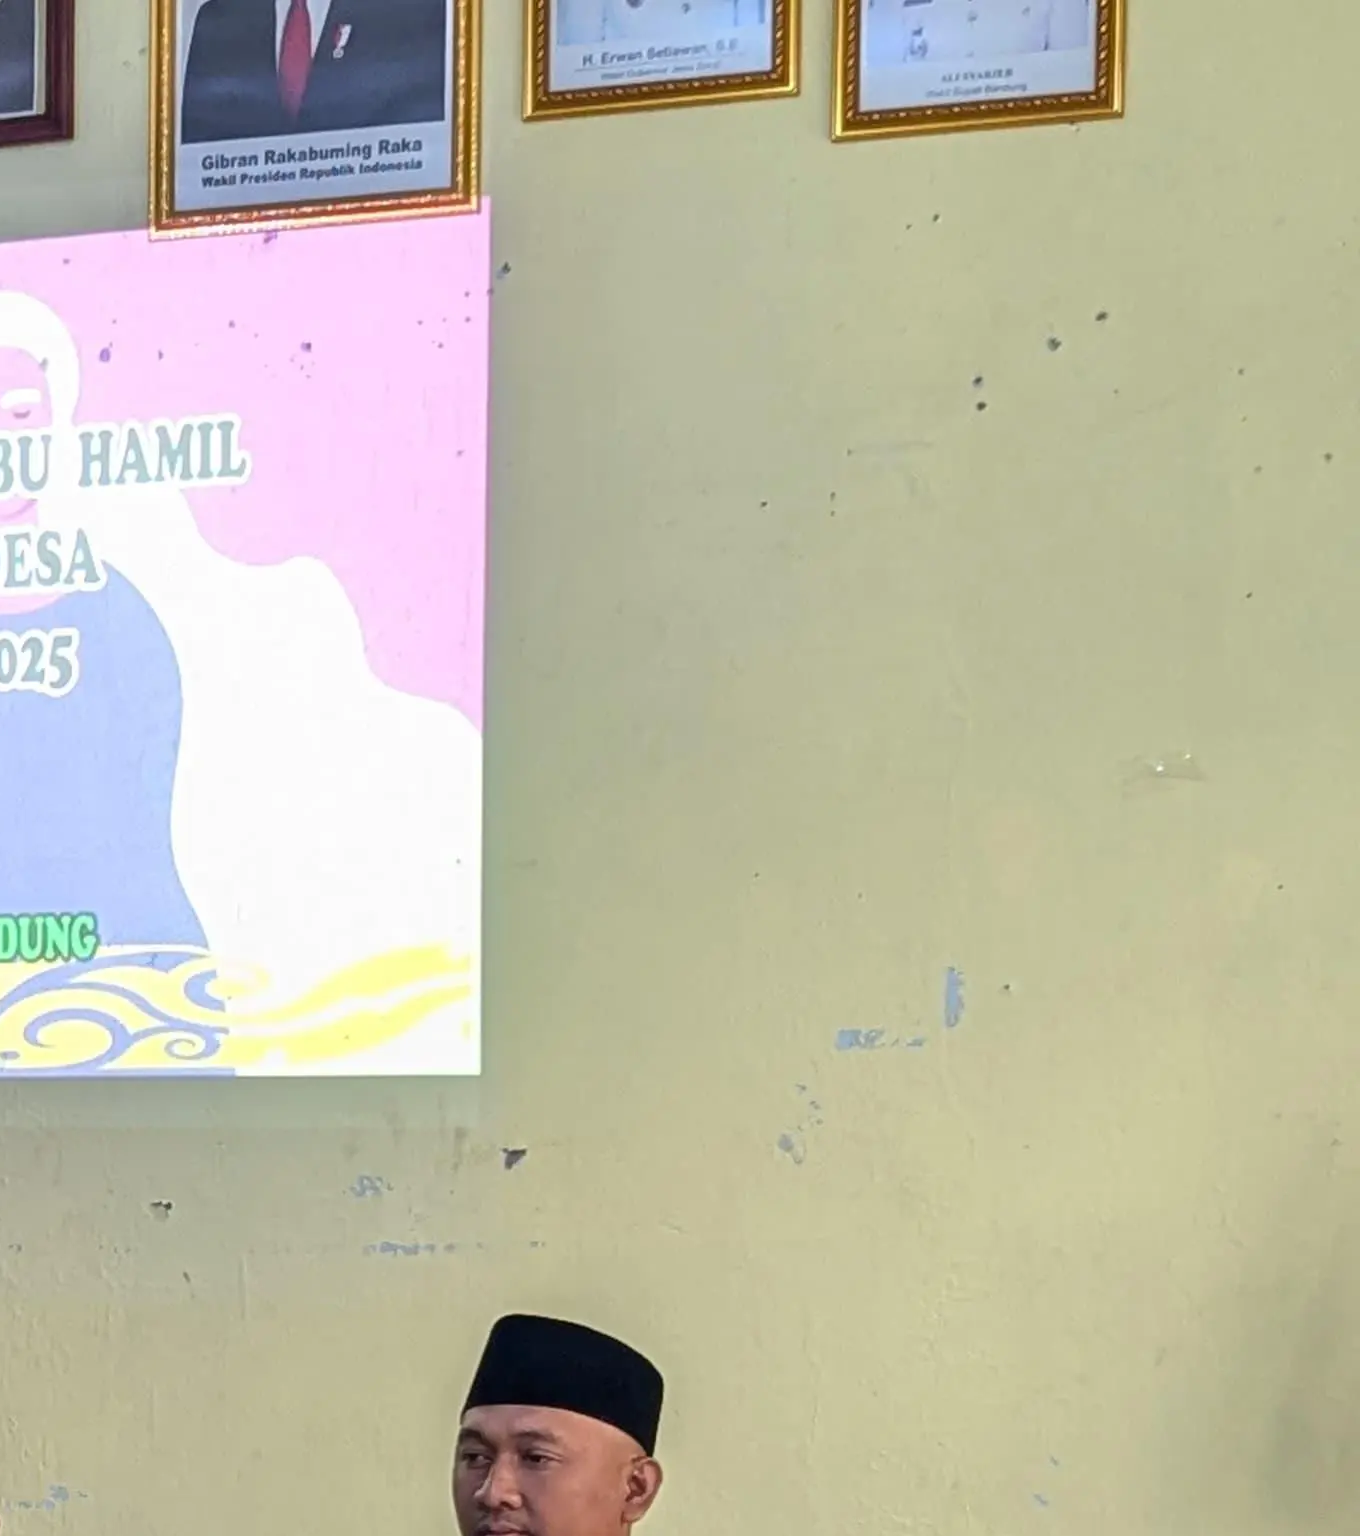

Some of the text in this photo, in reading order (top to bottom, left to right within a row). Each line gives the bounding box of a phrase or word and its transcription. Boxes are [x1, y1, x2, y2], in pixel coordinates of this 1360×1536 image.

[201, 137, 423, 171] Gibran Rakabuming Raka
[201, 158, 423, 188] Wakil Presiden Republik Indonesia
[78, 420, 247, 488] HAMIL
